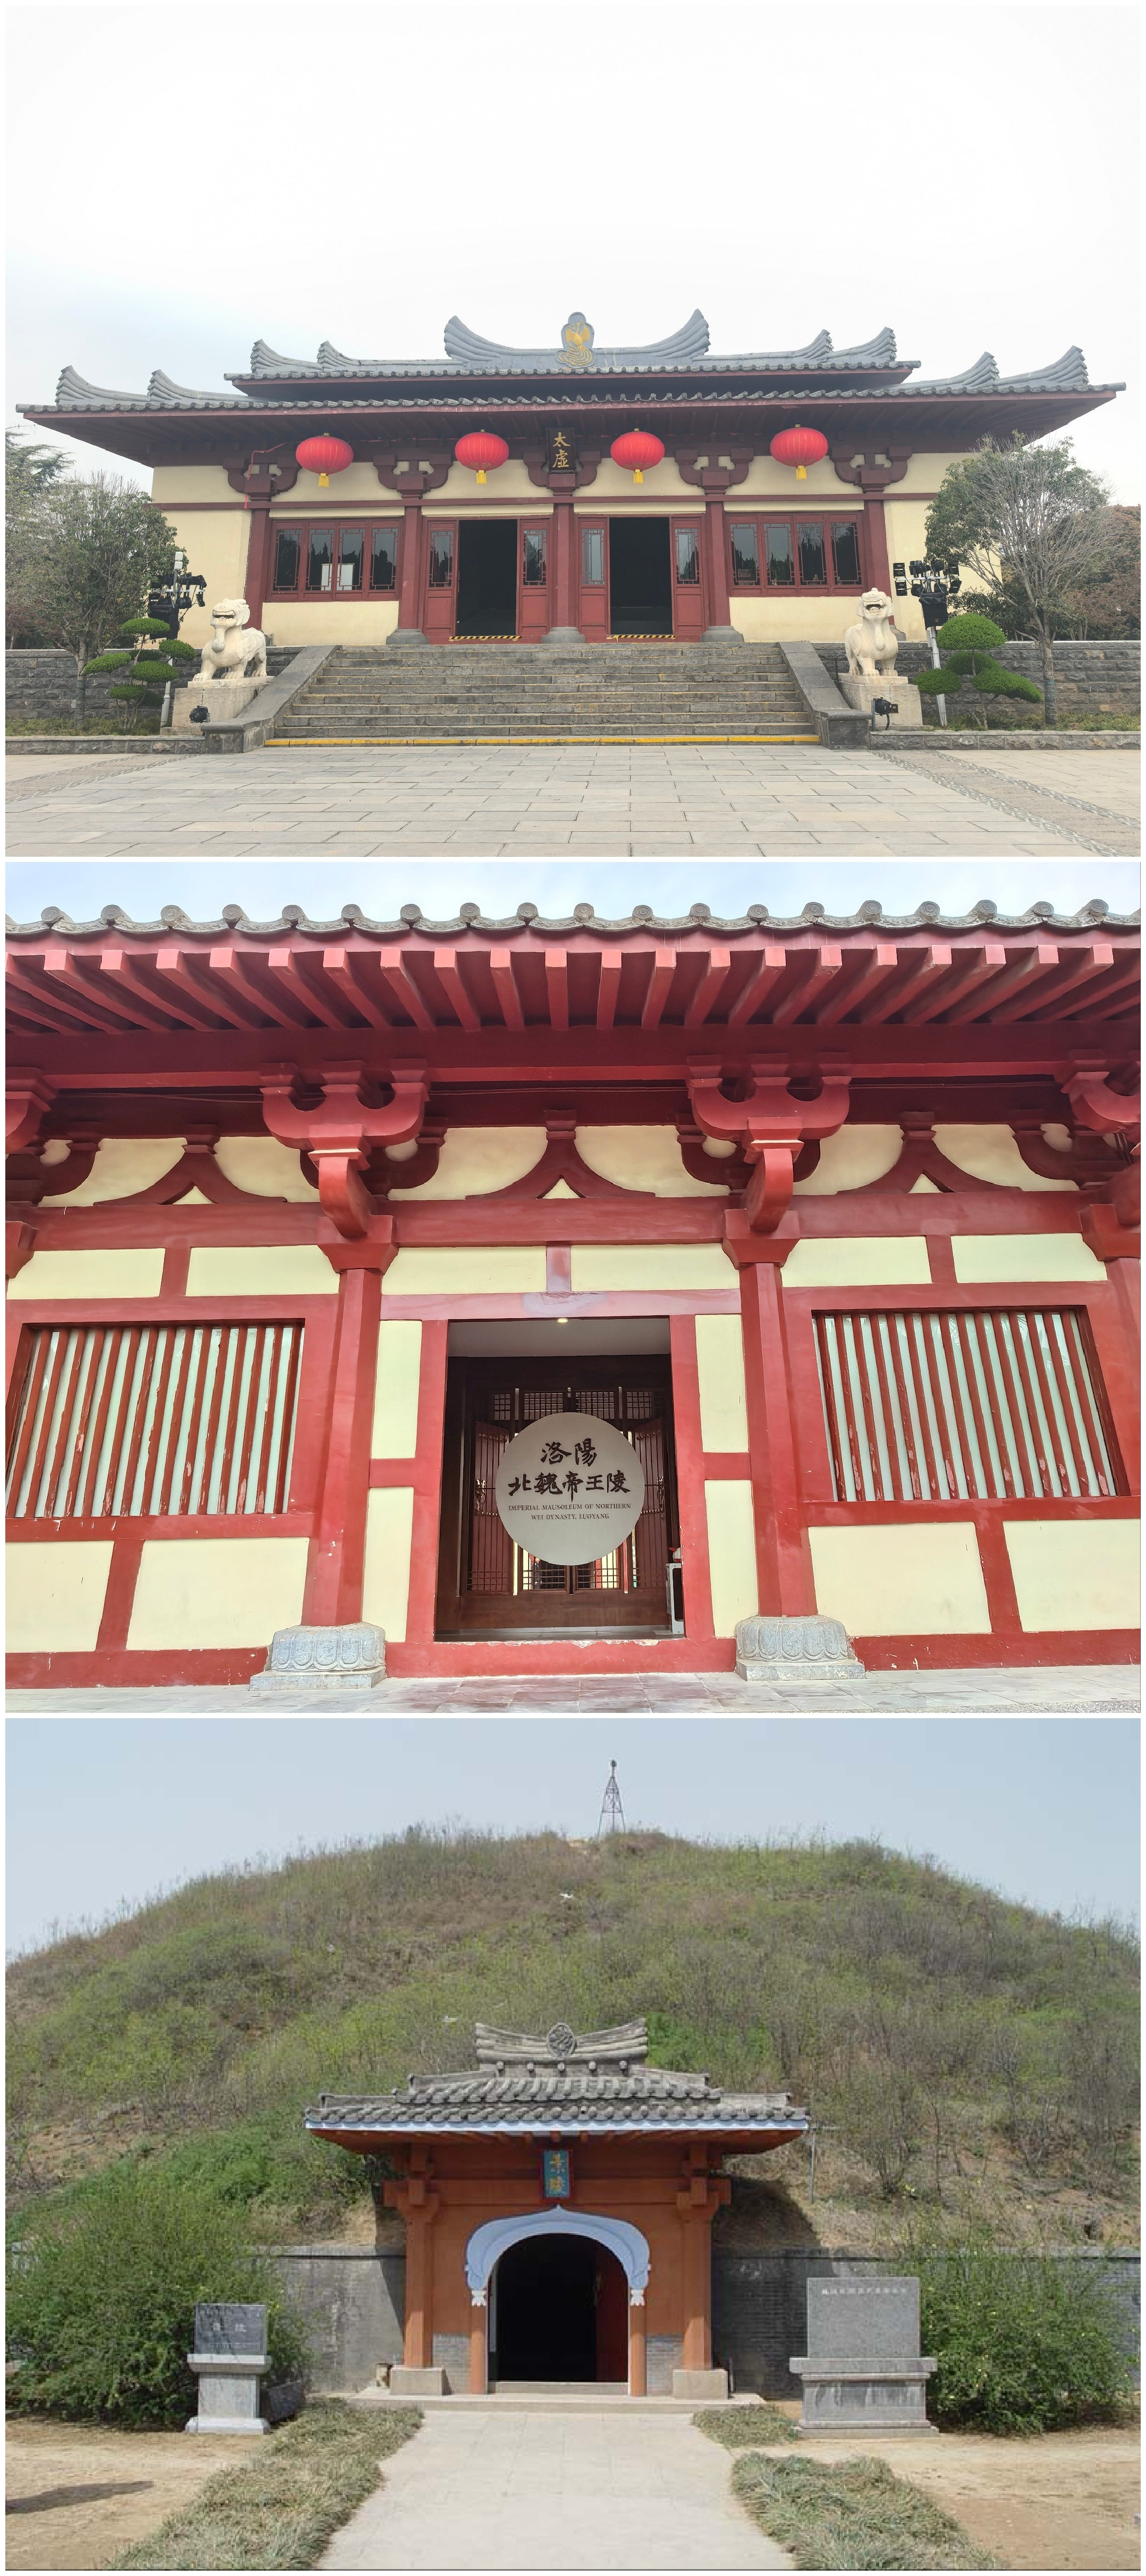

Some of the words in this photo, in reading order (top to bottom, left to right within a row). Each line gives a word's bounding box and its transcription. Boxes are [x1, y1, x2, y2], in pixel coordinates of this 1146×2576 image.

[540, 1438, 597, 1467] 洛陽
[508, 1469, 631, 1502] 北魏帝王陵
